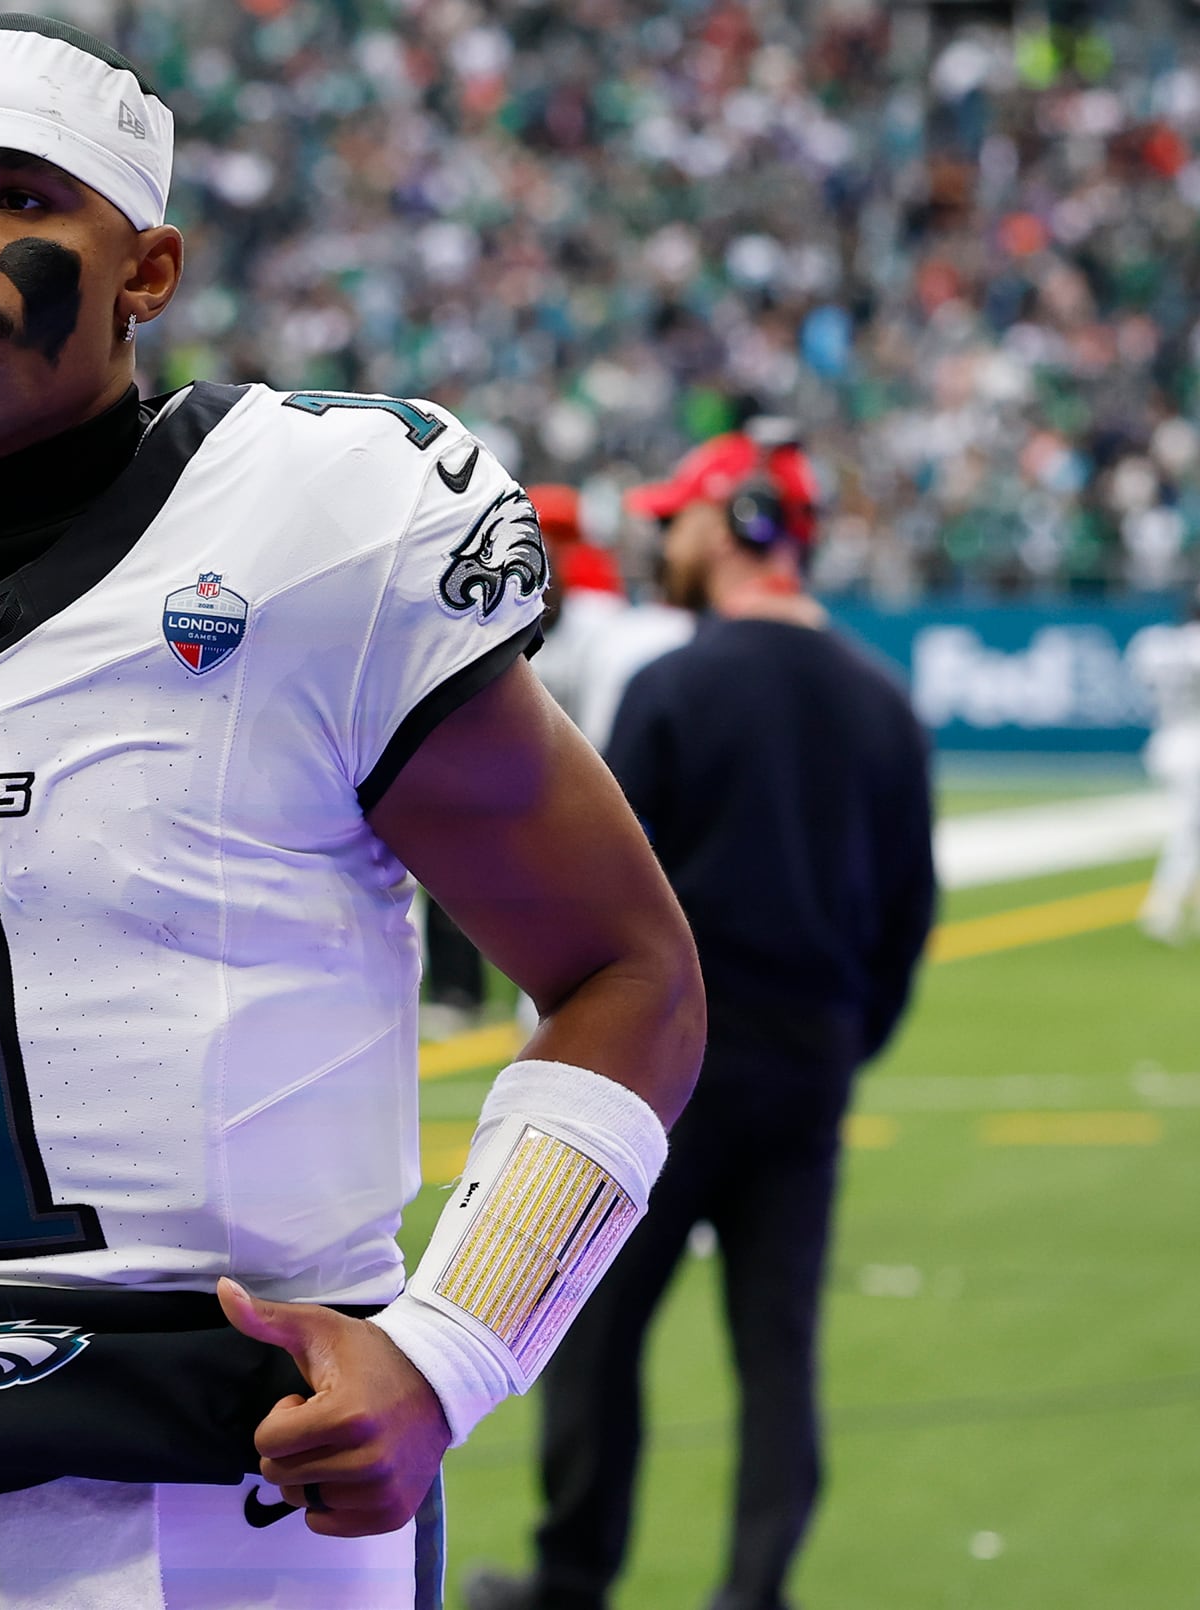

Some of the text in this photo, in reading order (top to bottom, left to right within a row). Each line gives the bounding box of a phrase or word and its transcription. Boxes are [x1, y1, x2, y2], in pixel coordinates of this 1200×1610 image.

[281, 392, 448, 450] 1
[198, 583, 218, 597] NFL
[168, 615, 240, 635] LONDON
[187, 632, 217, 642] GAMES
